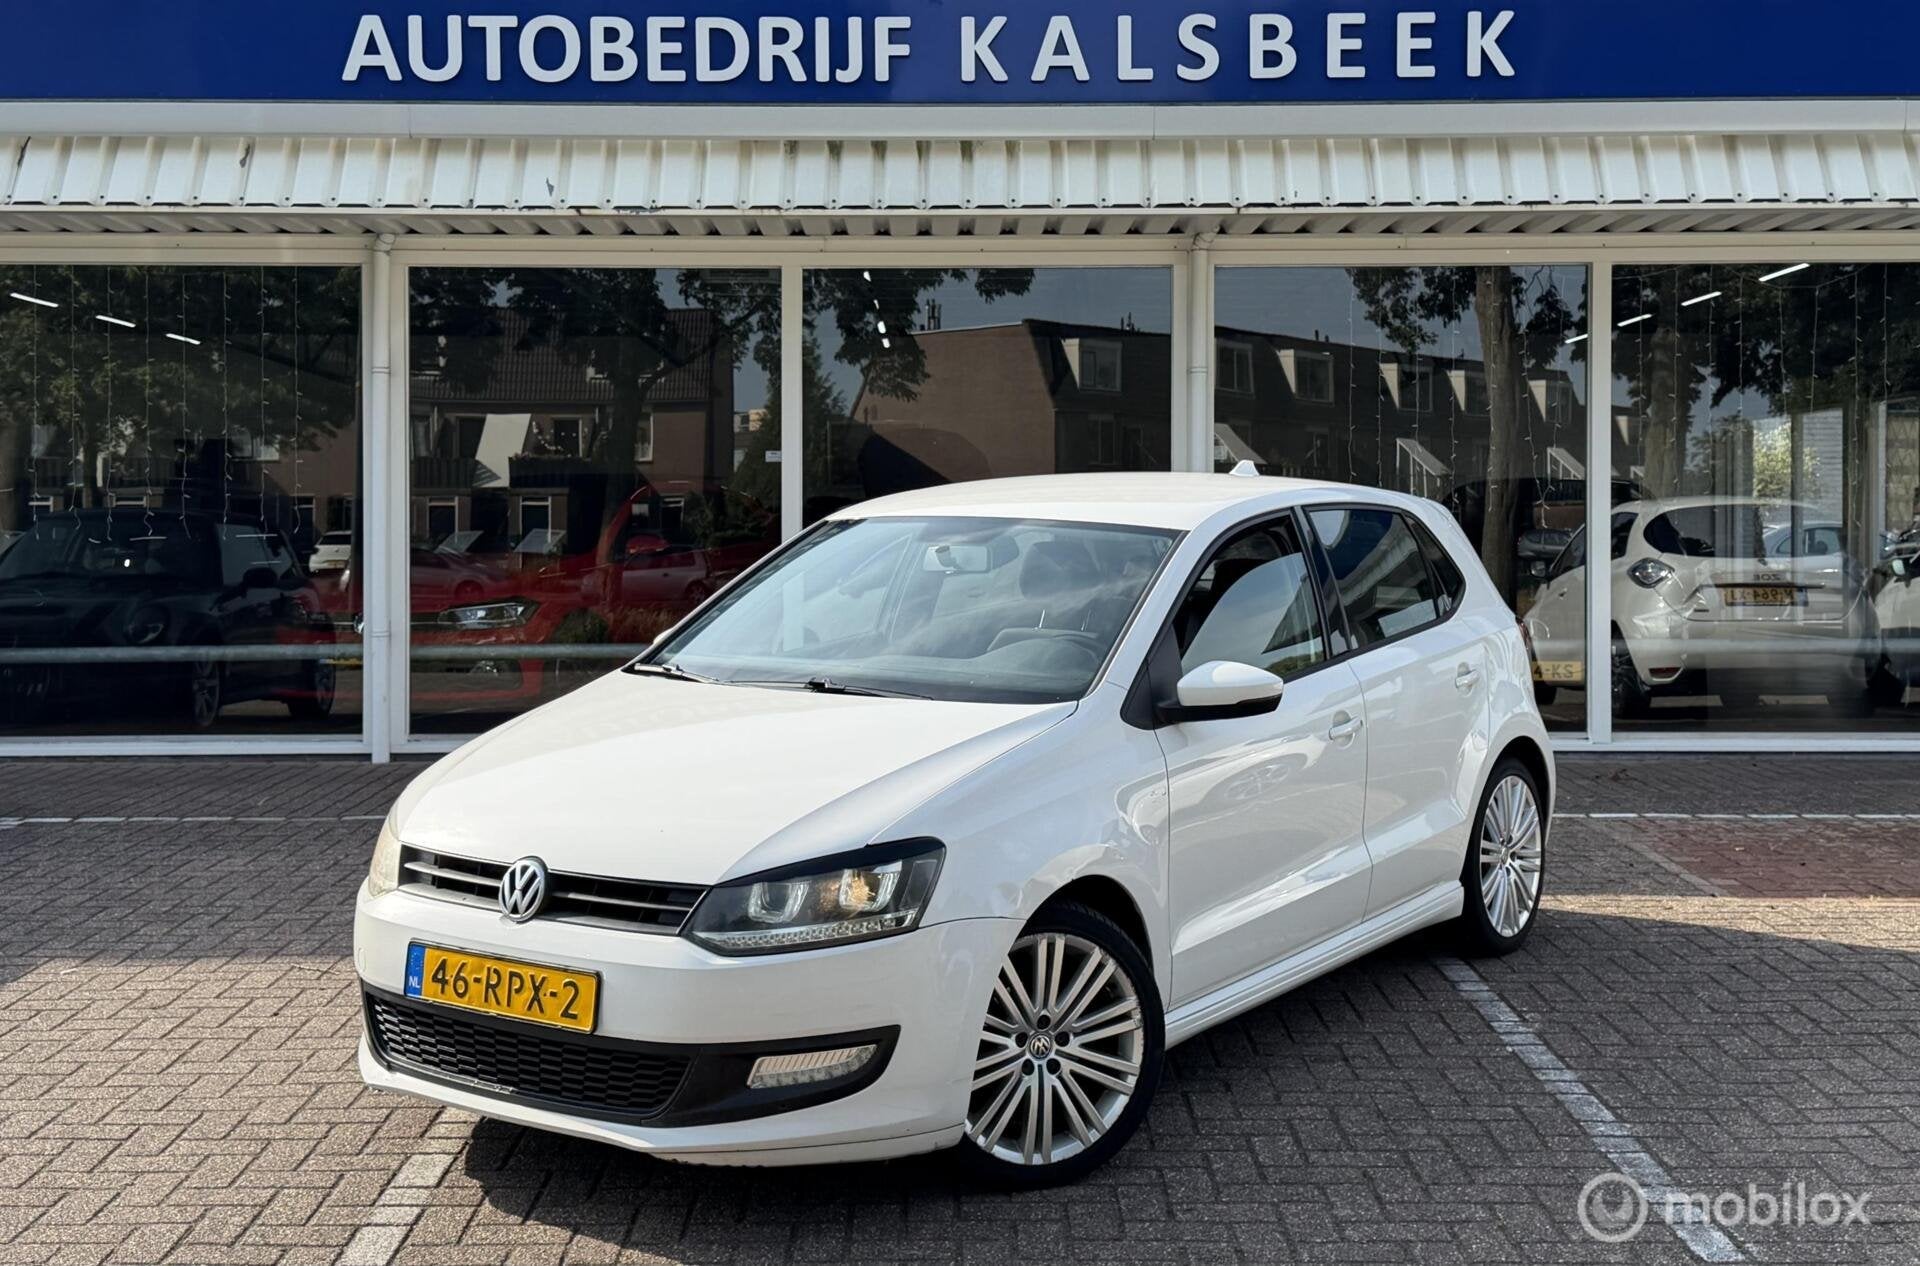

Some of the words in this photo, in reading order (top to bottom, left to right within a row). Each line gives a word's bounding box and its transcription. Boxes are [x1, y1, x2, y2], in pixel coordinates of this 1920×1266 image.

[341, 14, 912, 83] AUTOBEDRIJF
[960, 10, 1516, 82] KALSBEEK
[408, 976, 421, 989] NL
[431, 957, 580, 1020] 46-RPX-2
